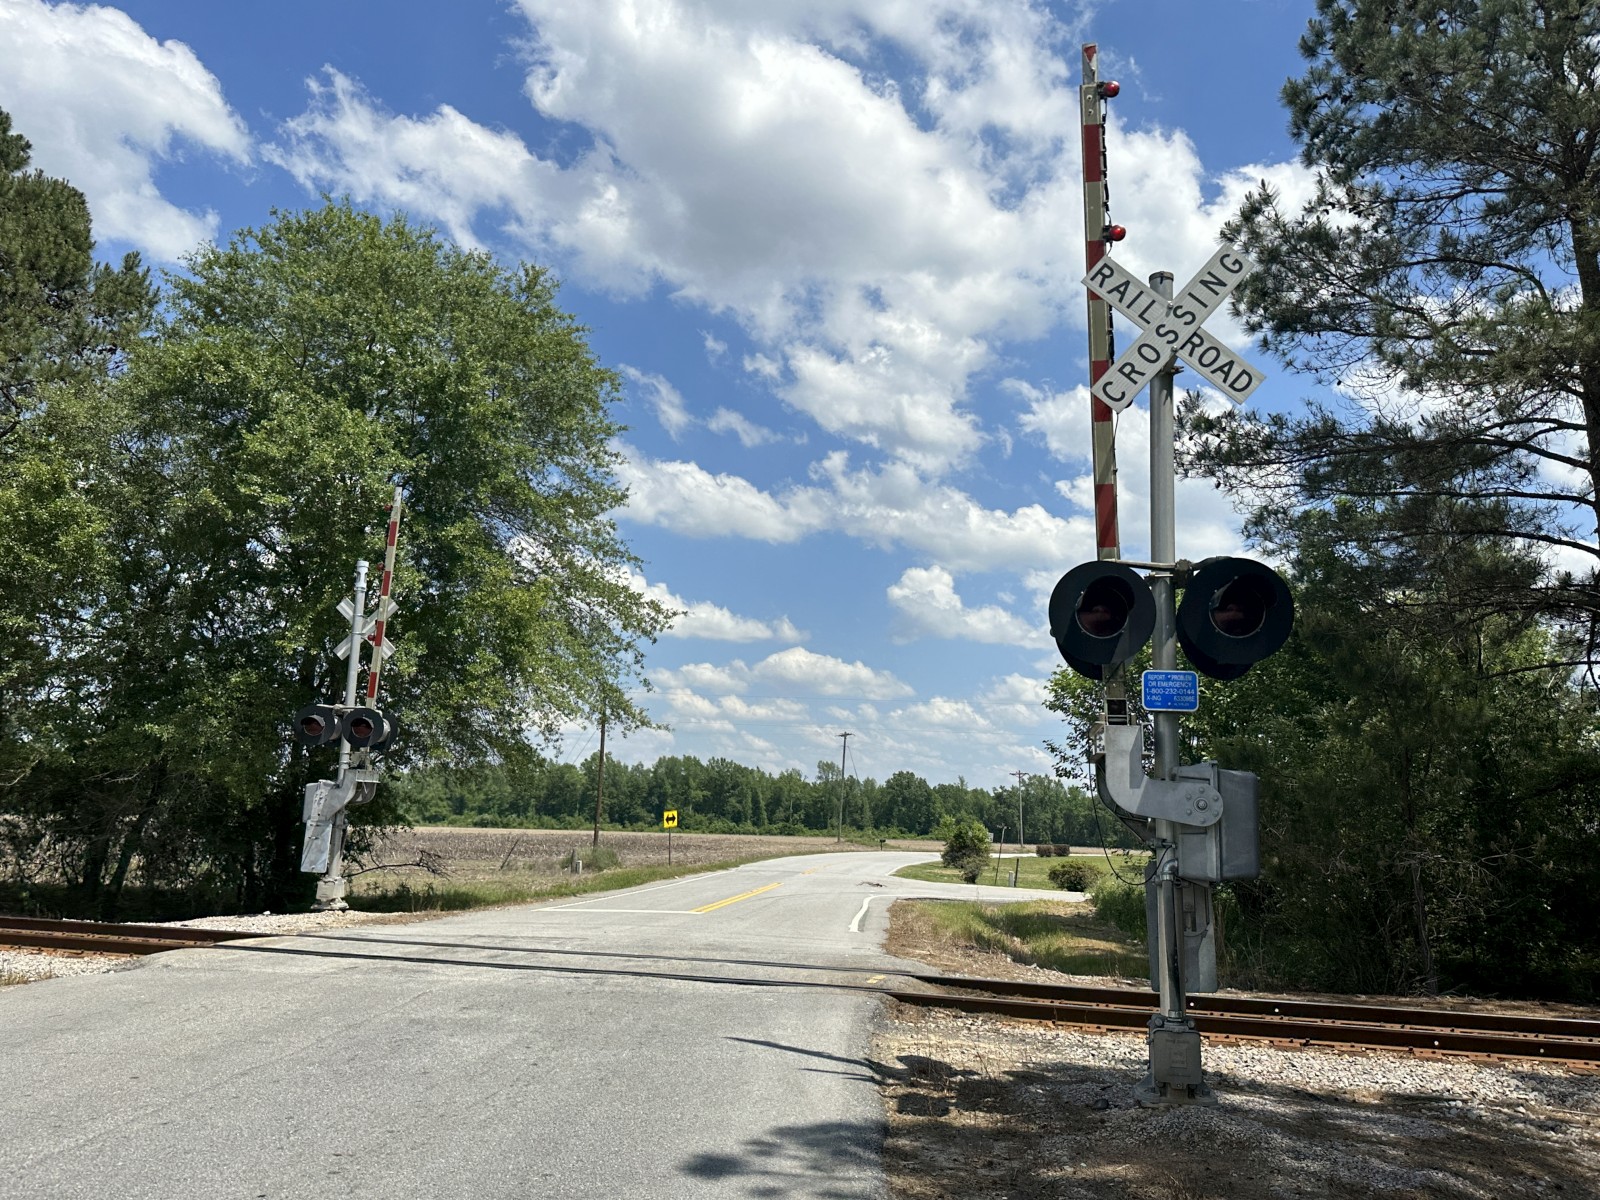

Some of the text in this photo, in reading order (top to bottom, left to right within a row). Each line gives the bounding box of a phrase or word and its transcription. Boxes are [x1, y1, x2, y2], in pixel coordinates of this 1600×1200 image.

[1089, 263, 1253, 393] RAIL ROAD
[1102, 253, 1244, 402] CROSSING
